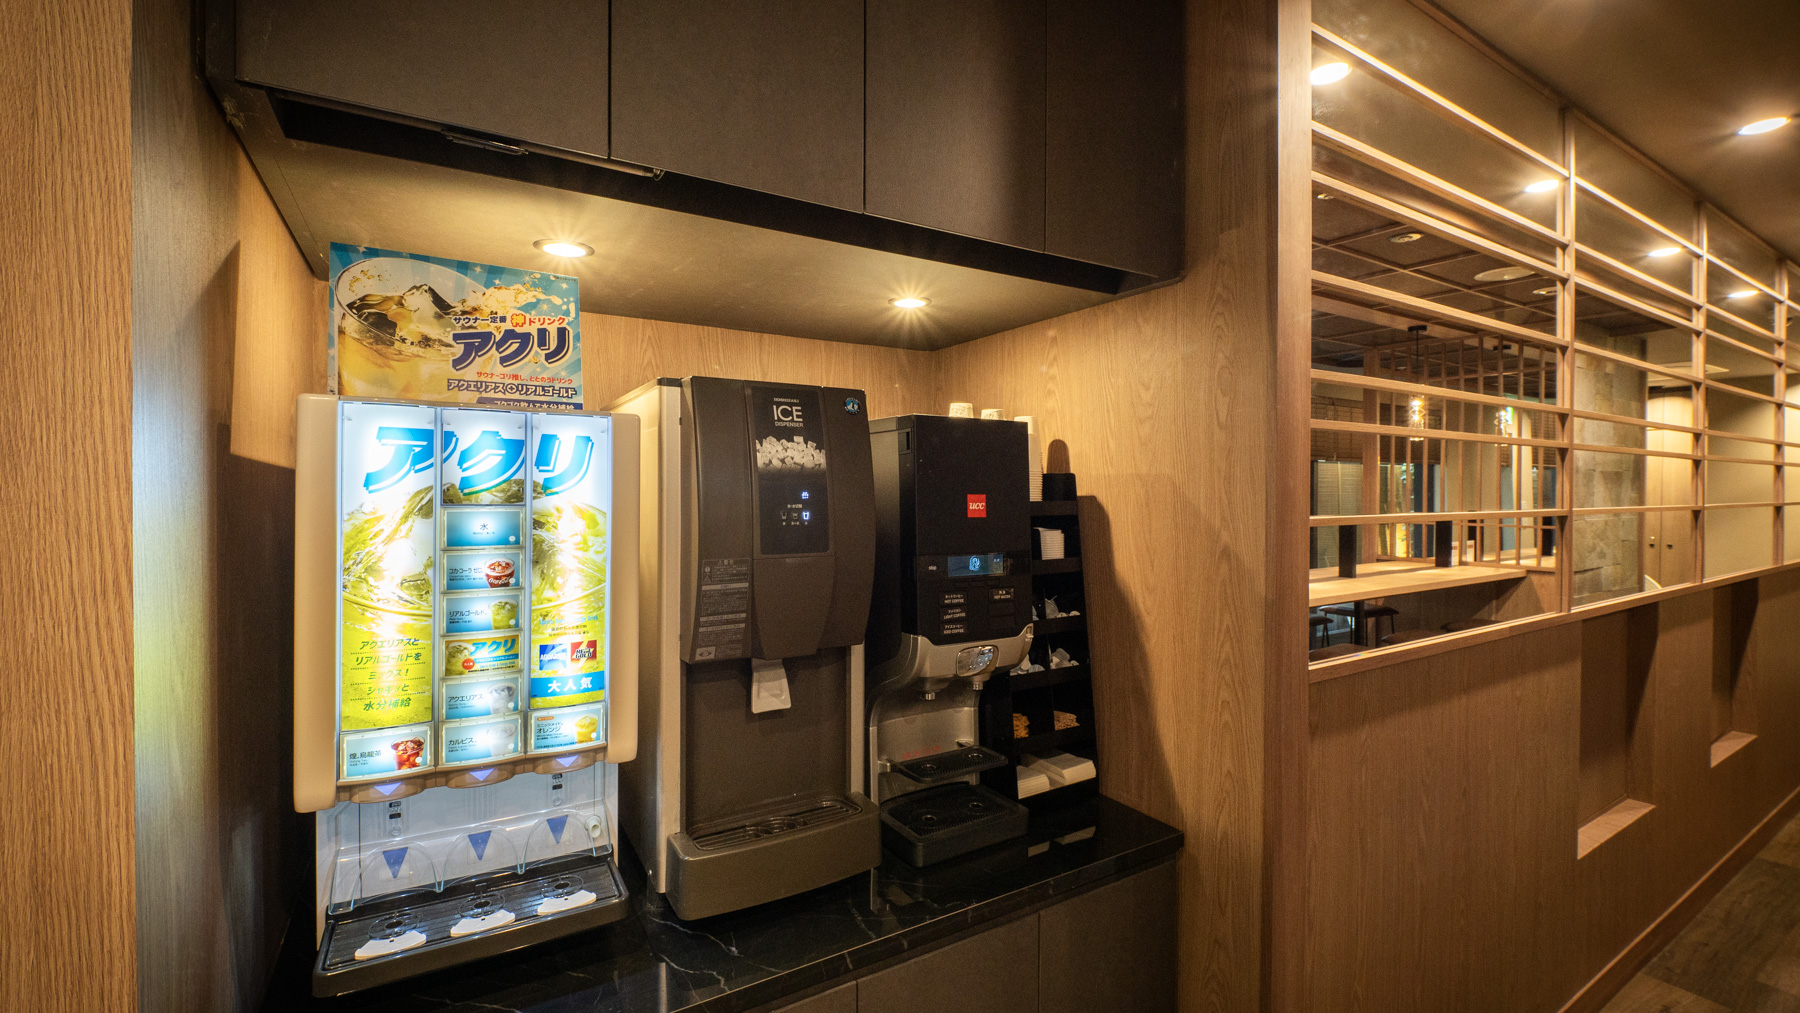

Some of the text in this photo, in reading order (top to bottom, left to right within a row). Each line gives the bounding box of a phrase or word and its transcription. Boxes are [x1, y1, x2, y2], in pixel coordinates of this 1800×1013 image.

[453, 315, 507, 324] サウナー定番
[452, 327, 569, 371] アクリ
[773, 405, 803, 421] ICE
[363, 426, 594, 497] アクリ
[360, 637, 420, 650] アクエリアスと
[470, 638, 516, 657] アクリ
[356, 652, 422, 666] リアルゴールドを
[548, 677, 592, 693] 大人気
[363, 697, 411, 711] 水分補給
[448, 694, 483, 702] アクエリアス
[537, 726, 561, 734] オレンジ
